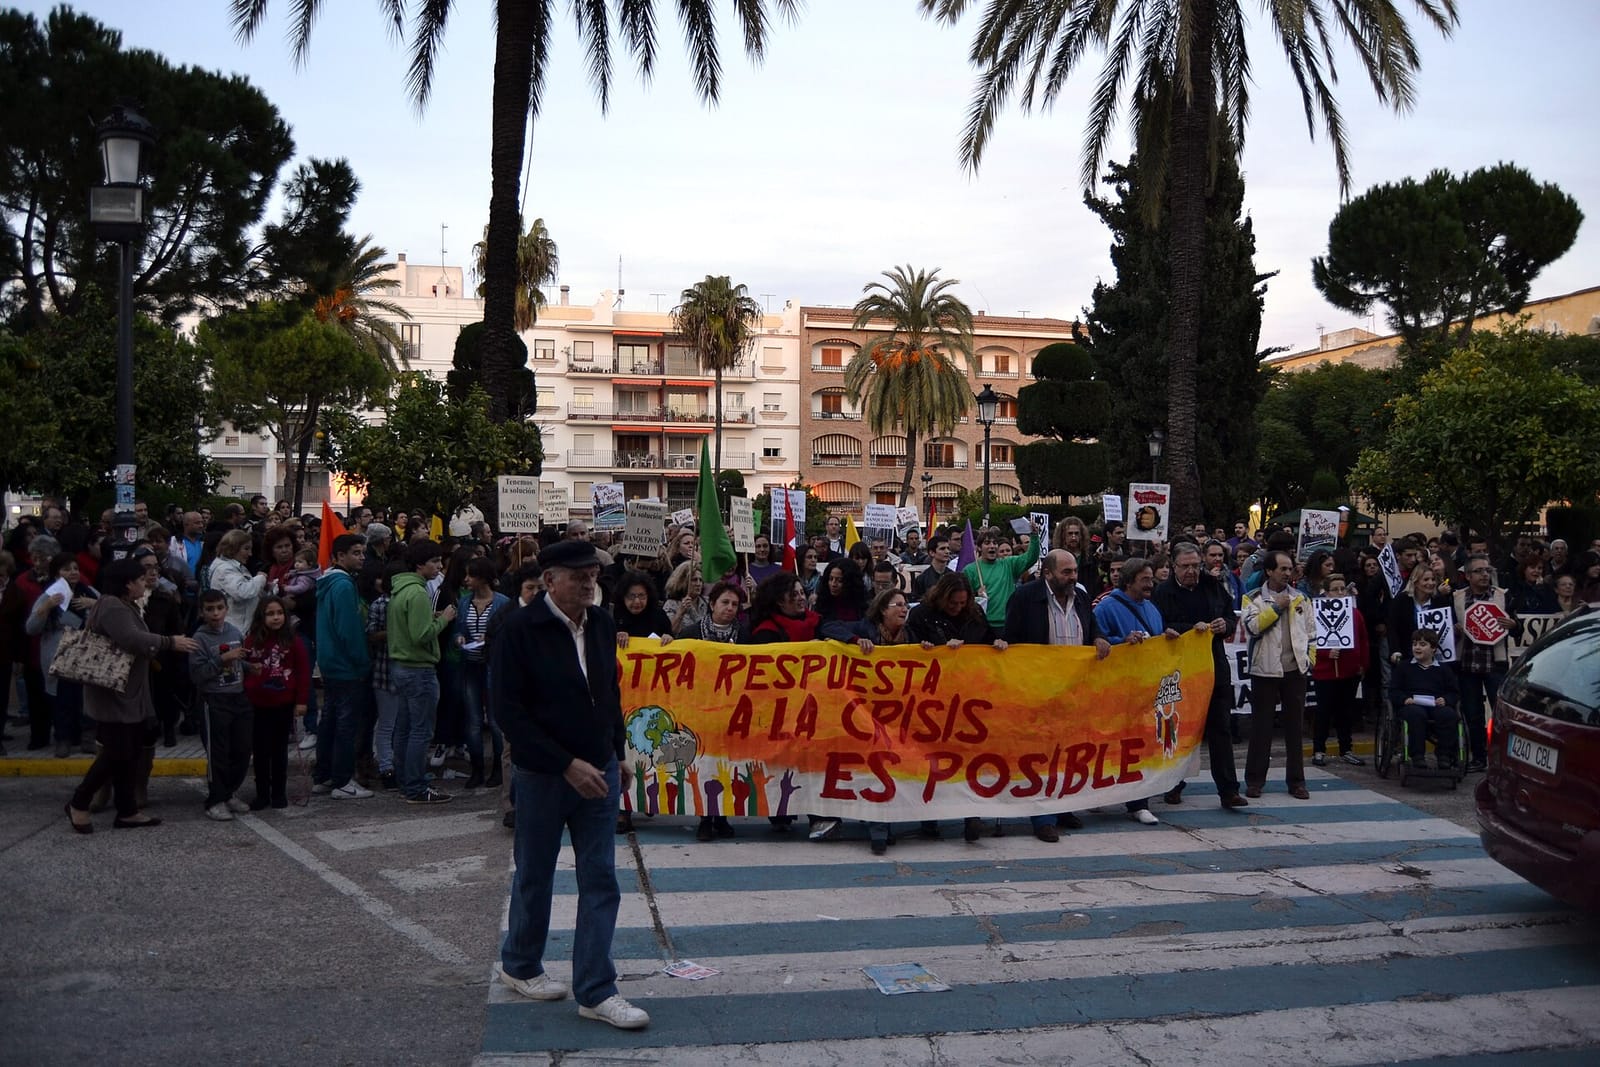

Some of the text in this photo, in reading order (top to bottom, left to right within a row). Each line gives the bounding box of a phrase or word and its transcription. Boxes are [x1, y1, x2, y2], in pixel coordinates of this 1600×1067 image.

[636, 503, 662, 511] Tenemos
[624, 534, 659, 543] BANQUEROS
[616, 651, 941, 696] TRA RESPUESTA
[727, 693, 993, 749] A LA CRISIS
[820, 738, 1145, 804] ES POSIBLE
[1512, 738, 1552, 770] 4240 CBL
